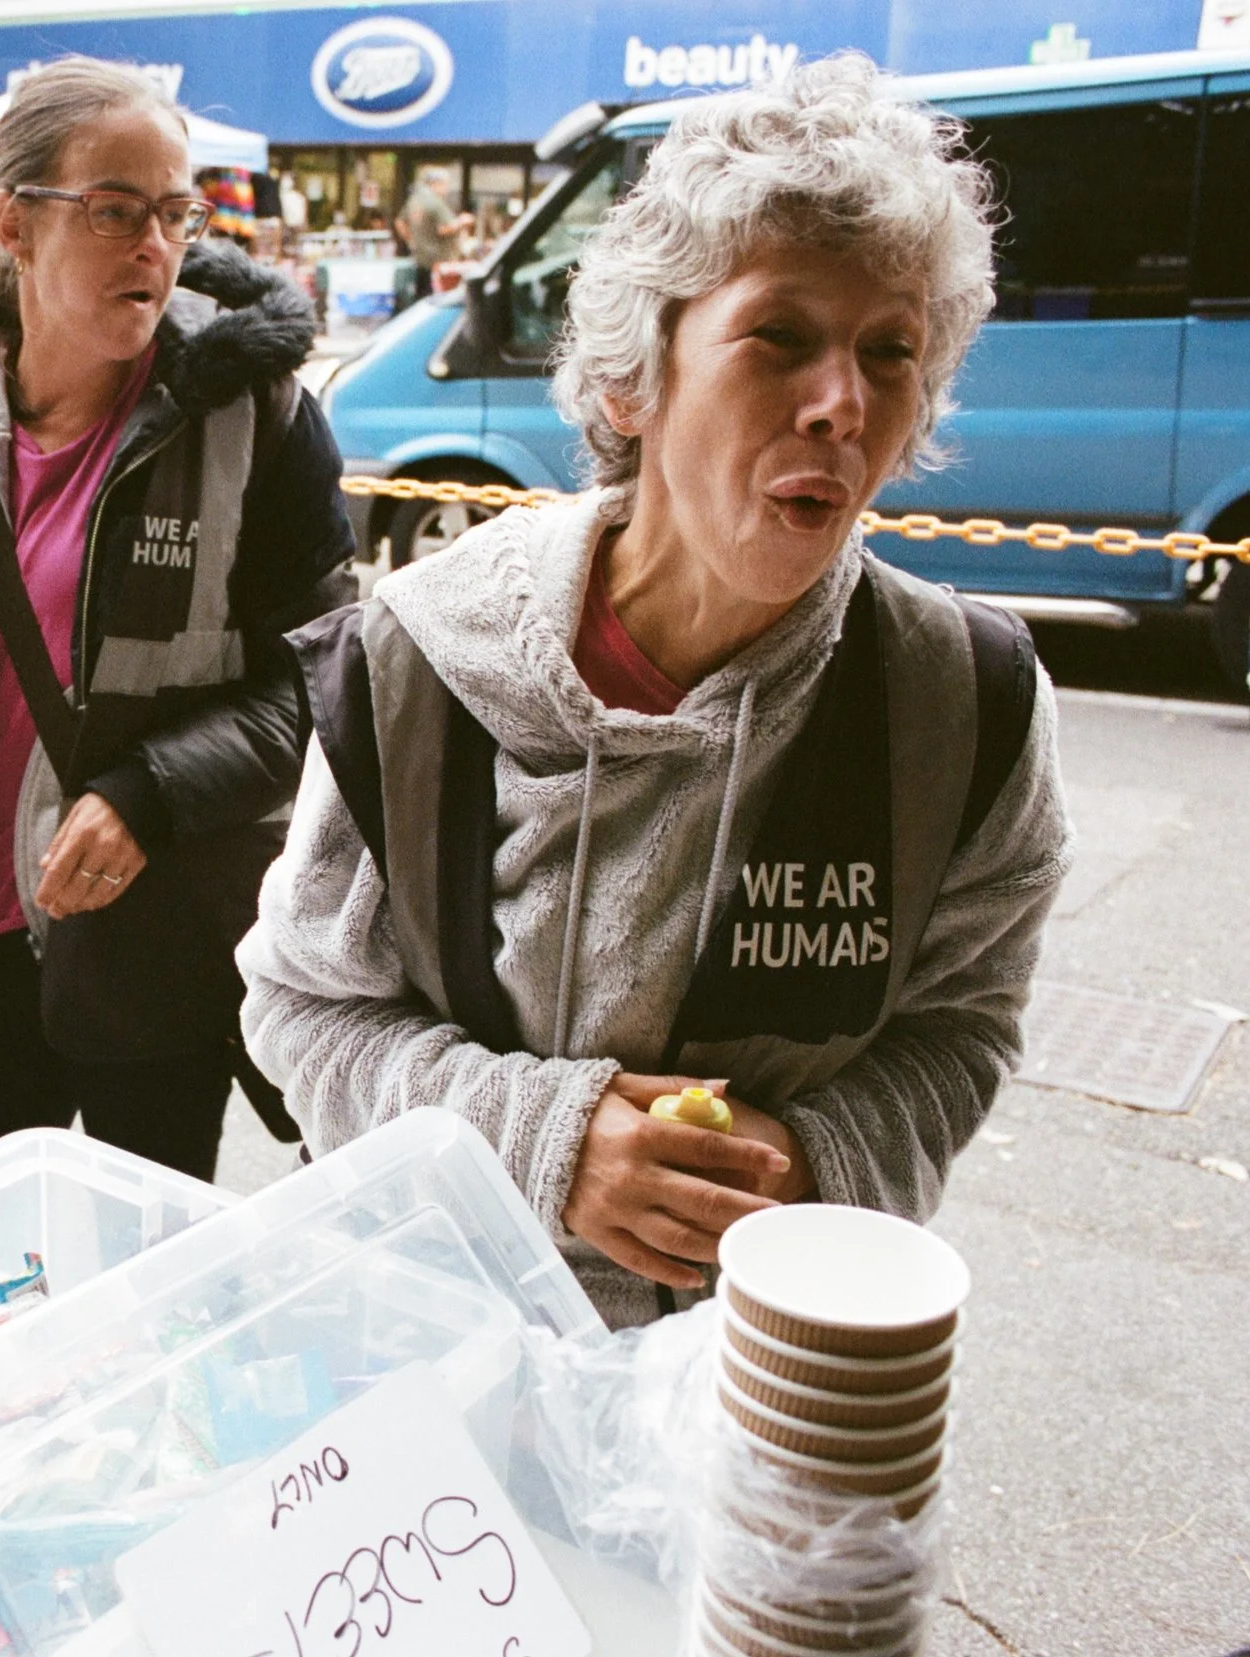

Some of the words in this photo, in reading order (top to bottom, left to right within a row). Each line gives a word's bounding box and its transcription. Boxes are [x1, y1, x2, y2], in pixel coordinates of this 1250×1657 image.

[624, 34, 798, 90] beauty
[144, 516, 181, 542] WE
[132, 541, 191, 568] HUM
[742, 862, 805, 908] WE
[816, 862, 876, 908] AR
[268, 1446, 351, 1530] ONLY
